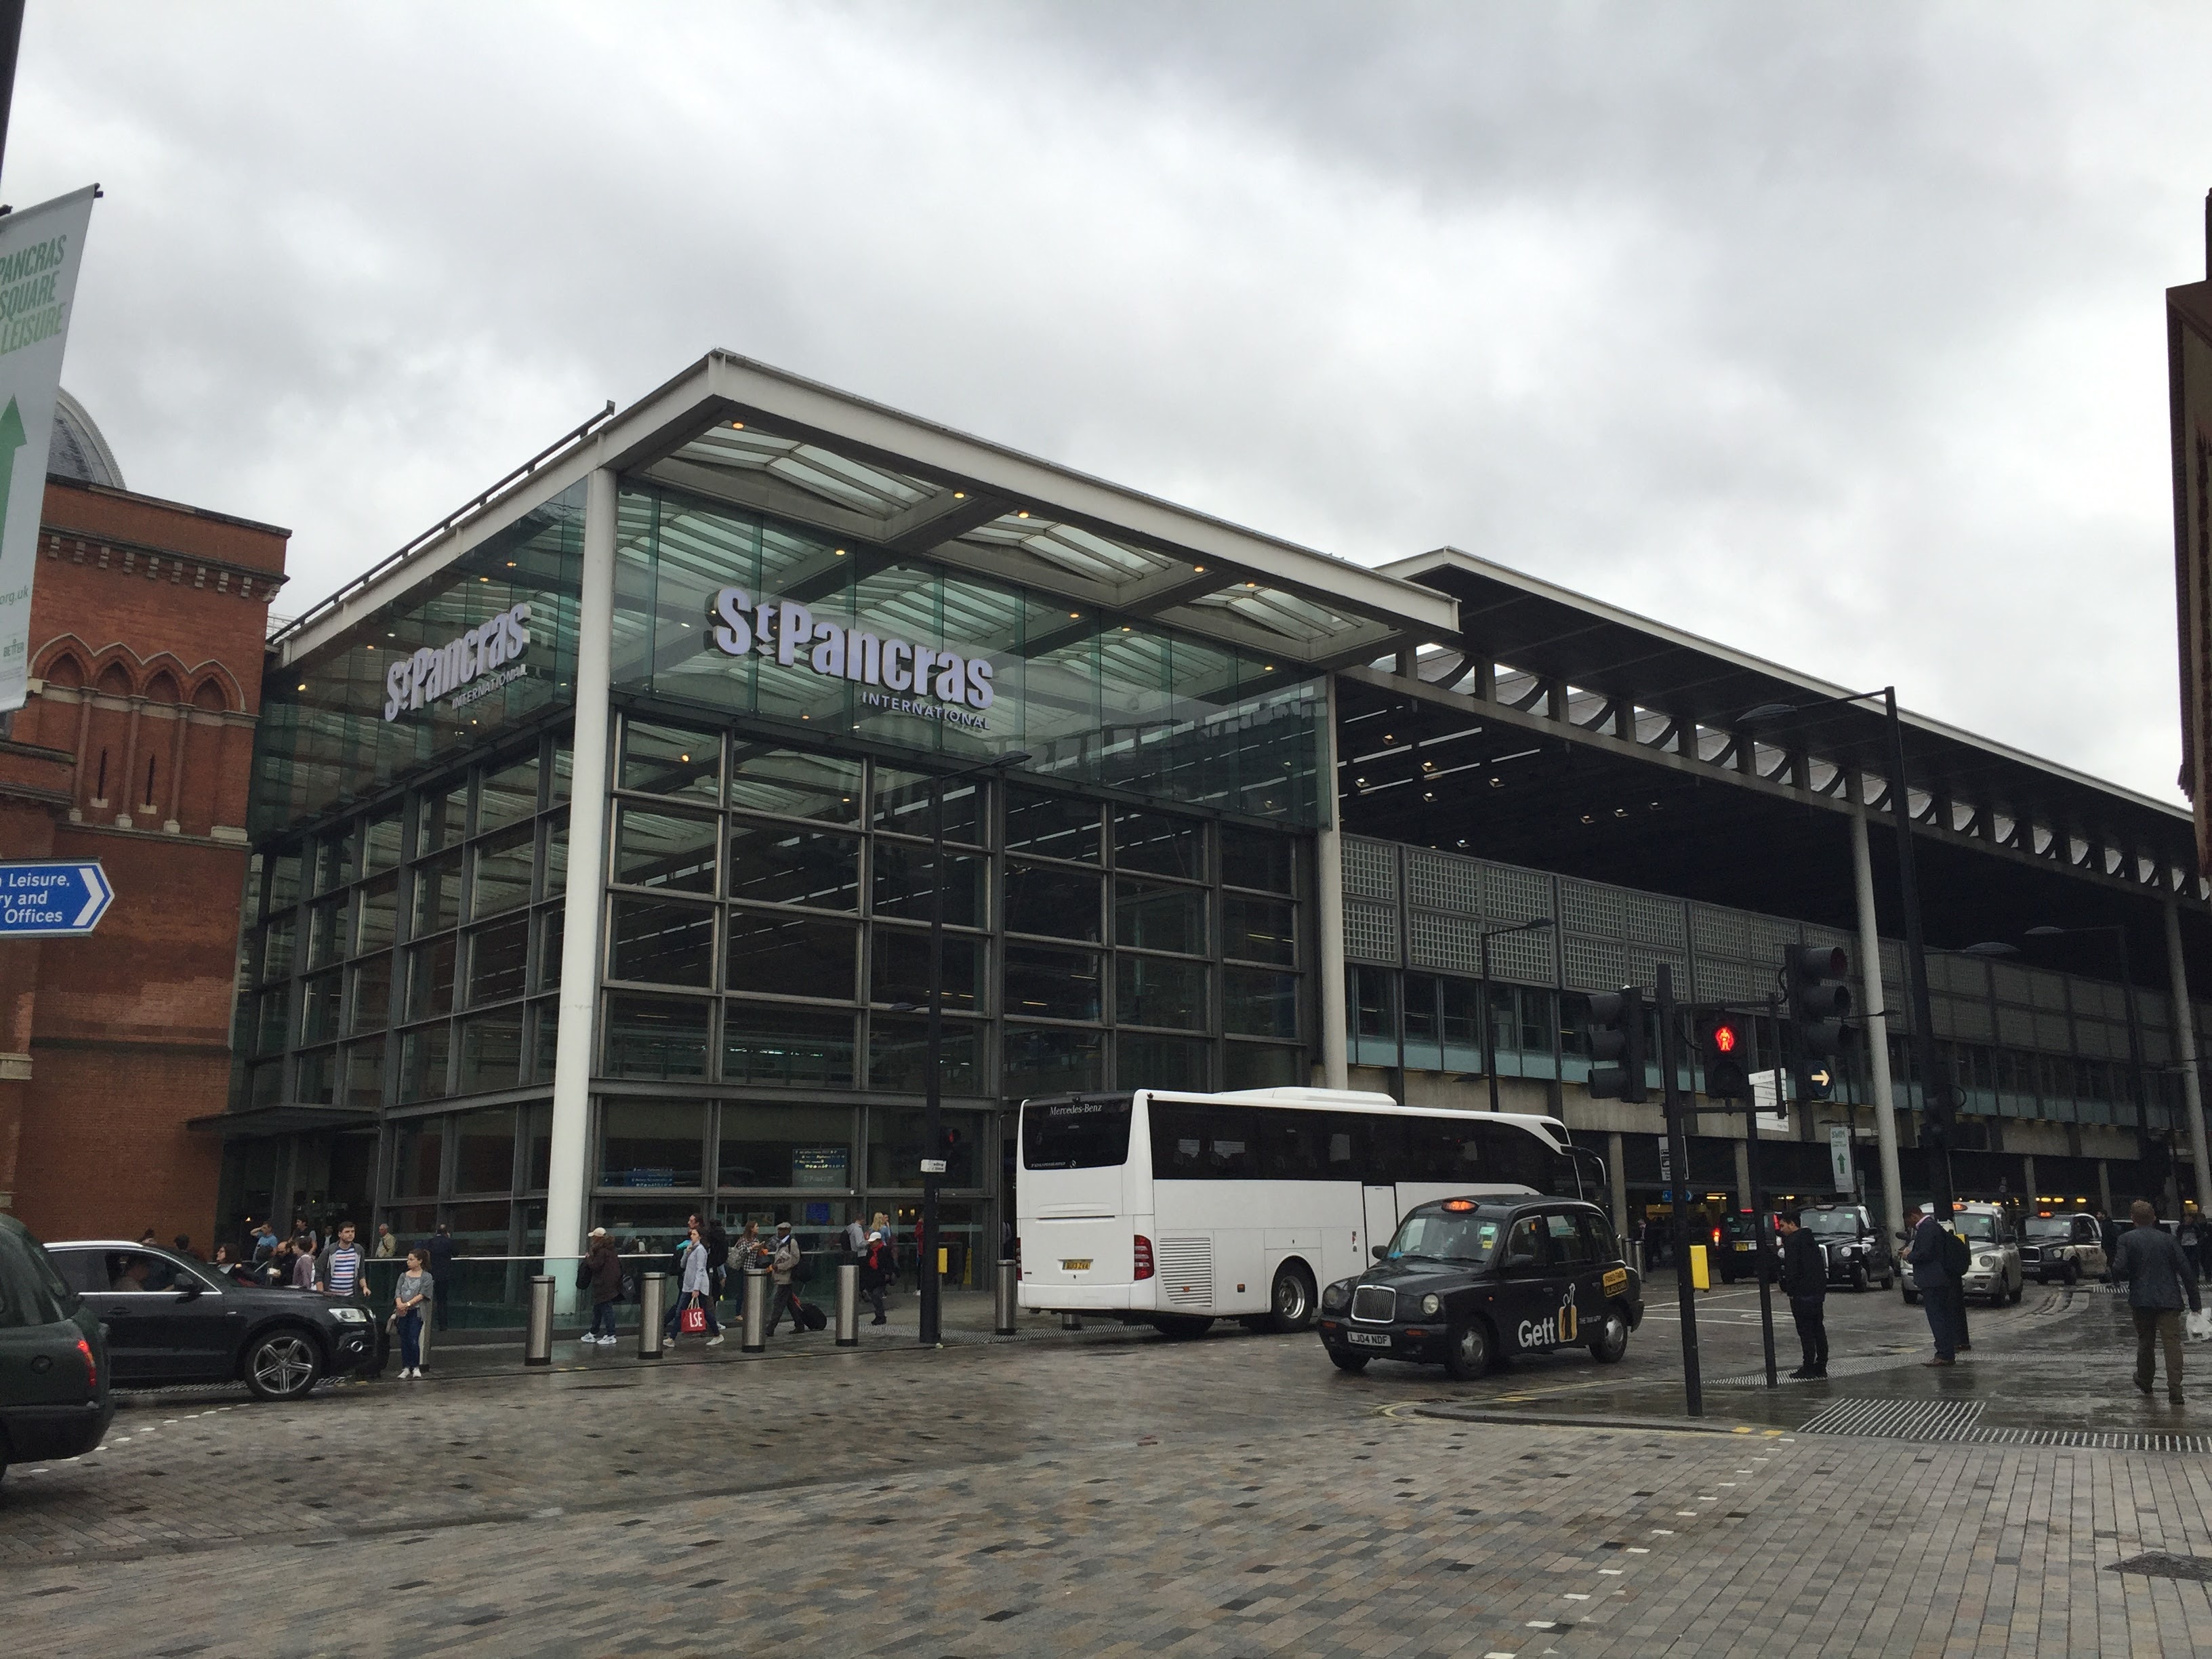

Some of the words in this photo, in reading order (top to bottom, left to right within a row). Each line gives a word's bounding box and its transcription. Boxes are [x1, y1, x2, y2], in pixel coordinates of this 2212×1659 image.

[0, 270, 60, 323] SQUARE
[1, 302, 66, 355] LEISURE
[410, 602, 531, 711] Pancras
[777, 600, 994, 710] Pancras
[452, 663, 527, 710] INTERNATIONAL
[861, 691, 990, 730] INTERNATIONAL
[18, 890, 47, 905] and
[5, 909, 62, 924] Offices
[1049, 1103, 1103, 1115] Mercedes-Benz
[689, 1311, 703, 1328] LSE
[1518, 1317, 1556, 1347] Gett
[1350, 1333, 1370, 1343] LJ04
[1371, 1335, 1387, 1344] NDF
